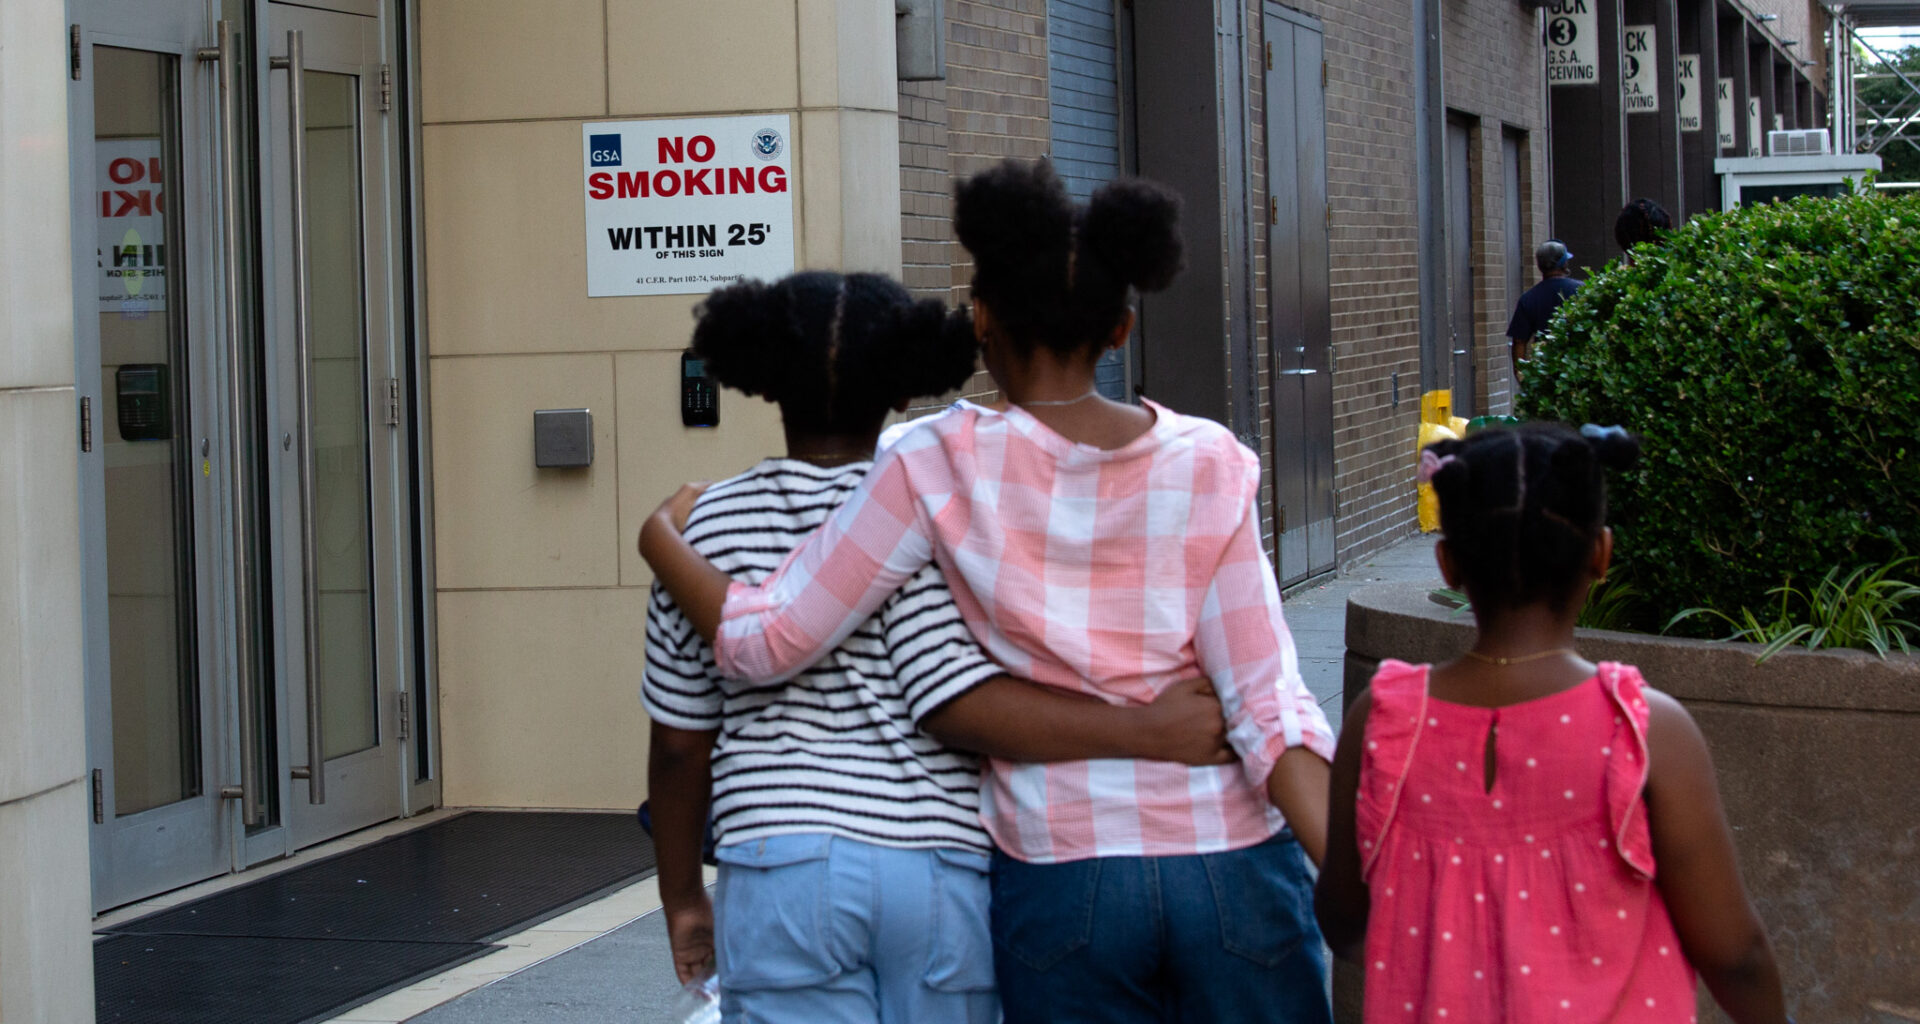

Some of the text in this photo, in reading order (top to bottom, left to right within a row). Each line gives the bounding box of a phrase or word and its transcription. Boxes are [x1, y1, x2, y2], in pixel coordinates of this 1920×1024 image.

[1555, 19, 1571, 44] 3
[1549, 50, 1581, 64] G.S.A.
[1549, 64, 1593, 80] CEIVING
[592, 149, 621, 163] GSA
[657, 135, 716, 164] NO
[588, 165, 788, 200] SMOKING
[607, 222, 771, 250] WITHIN 25'
[655, 248, 724, 260] OF THIS SIGN
[635, 277, 644, 285] 41
